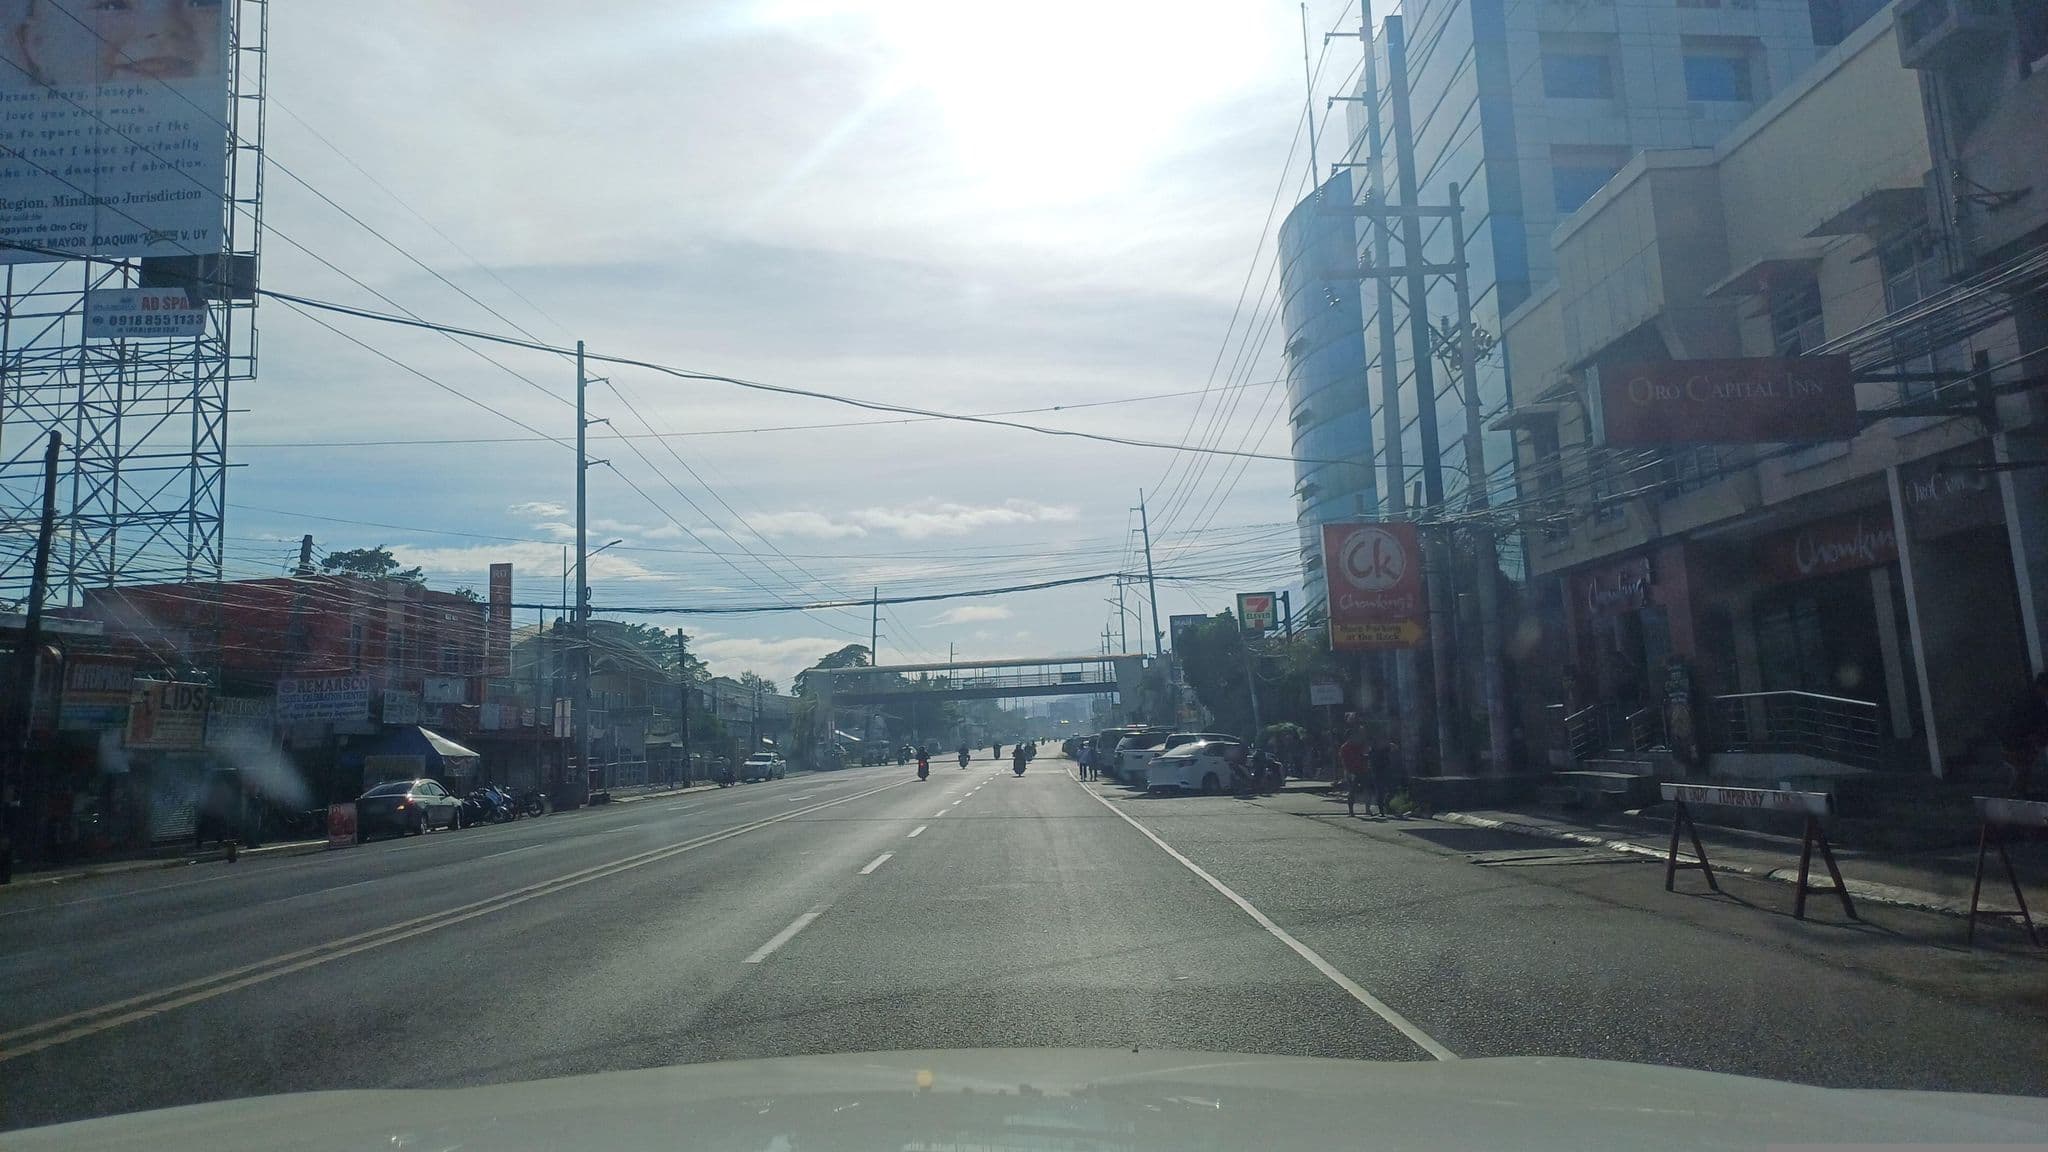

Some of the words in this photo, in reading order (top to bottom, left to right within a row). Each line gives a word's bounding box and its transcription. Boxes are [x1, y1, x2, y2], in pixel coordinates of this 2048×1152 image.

[168, 121, 190, 132] the
[52, 194, 119, 208] Mindanao
[122, 189, 202, 204] Jurisdiction
[0, 225, 34, 236] agayan
[36, 224, 48, 233] de
[50, 223, 67, 232] Oro
[69, 221, 88, 232] City
[48, 237, 87, 249] MAYOR
[91, 233, 139, 248] JOAQUIN
[193, 228, 208, 240] UY
[1794, 518, 1896, 575] Chowkin
